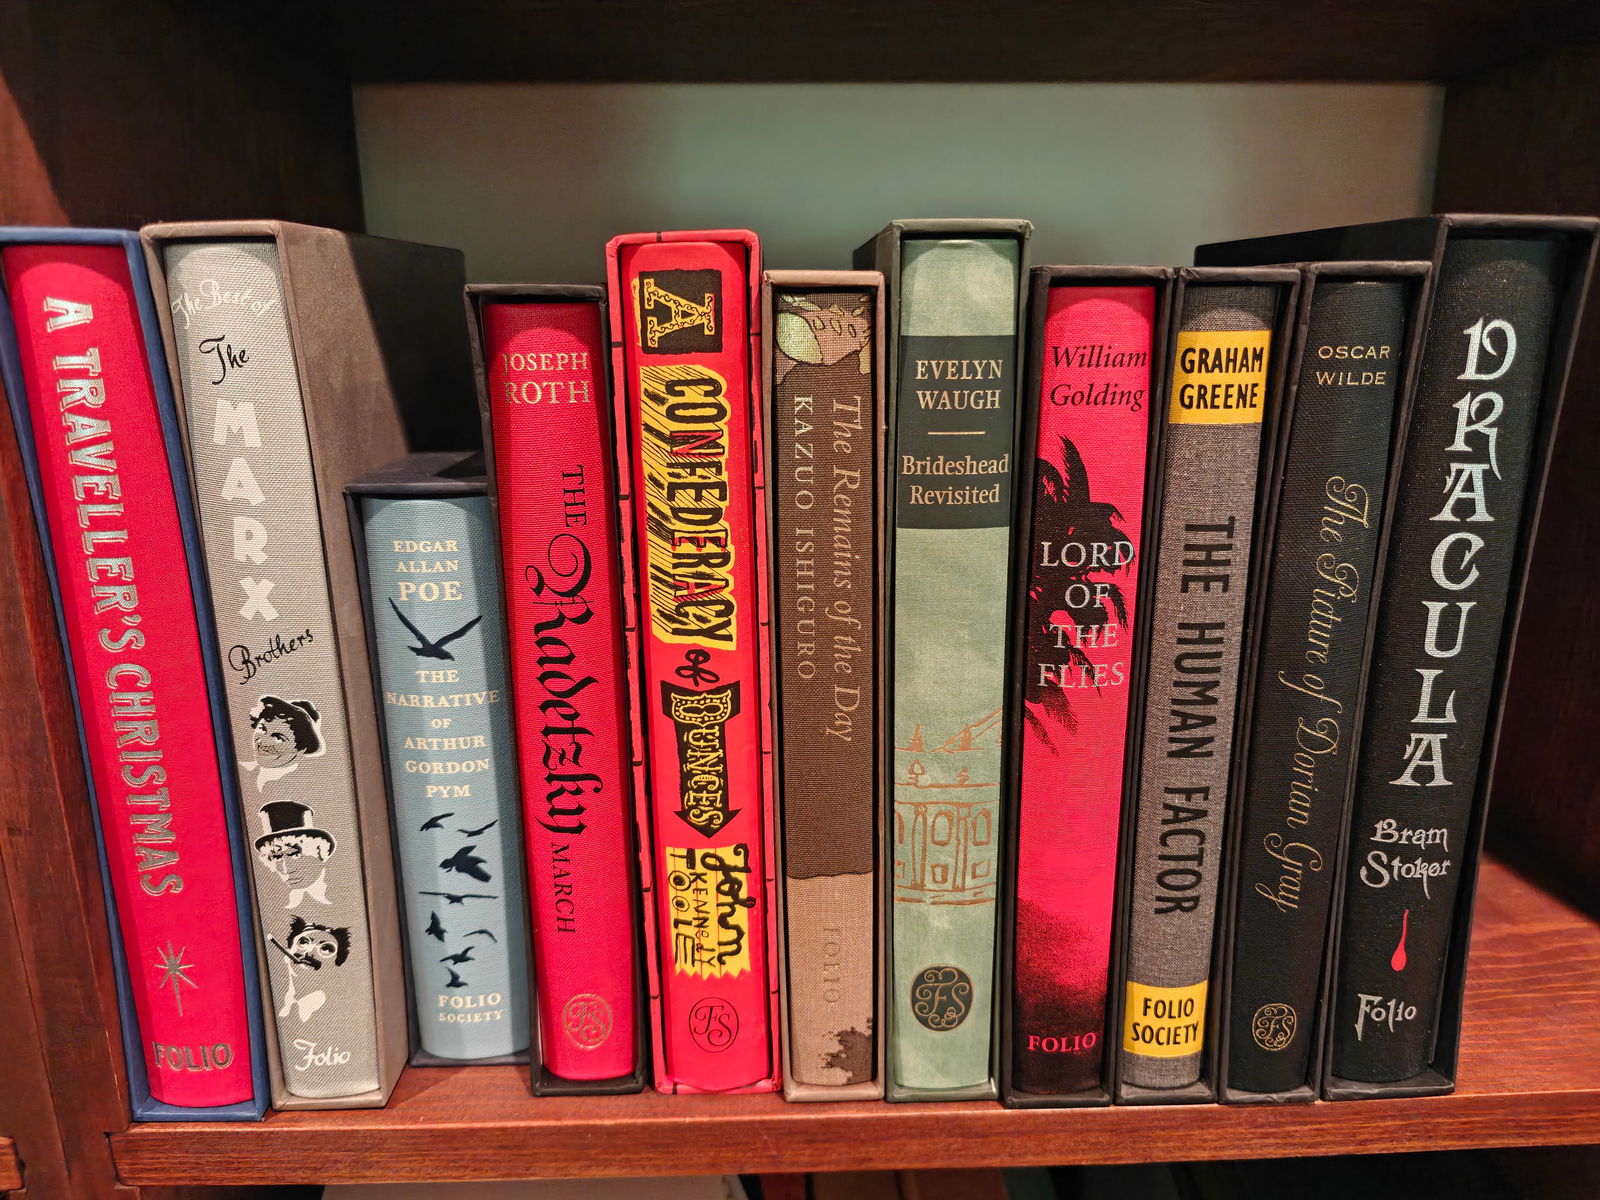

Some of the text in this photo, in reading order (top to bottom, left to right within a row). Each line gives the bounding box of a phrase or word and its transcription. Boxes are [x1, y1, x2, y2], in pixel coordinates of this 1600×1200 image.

[199, 335, 250, 385] The
[503, 351, 589, 376] JOSEPH
[1052, 344, 1147, 369] William
[1180, 347, 1265, 374] GRAHAM
[1317, 345, 1390, 360] OSCAR
[914, 359, 1004, 381] EVELYN
[1316, 371, 1387, 386] WILDE
[505, 380, 591, 405] ROTH
[915, 389, 1001, 411] WAUGH
[1050, 382, 1145, 413] Golding
[1179, 382, 1260, 410] GREENE
[901, 453, 1010, 477] Brideshead
[909, 484, 1001, 506] Revisited
[212, 399, 280, 622] MARX
[392, 540, 458, 553] EDGAR
[793, 395, 817, 680] KAZUO ISHIGURO
[643, 277, 735, 829] A CONFEDERACY of DUNCES
[1040, 540, 1135, 568] LORD
[1389, 316, 1518, 787] DRACULA
[396, 560, 459, 573] ALLAN
[825, 395, 862, 743] The Remains of the Day
[43, 296, 94, 333] A
[105, 663, 184, 897] CHRISTMAS
[399, 581, 463, 602] POE
[1064, 583, 1111, 609] OF
[1048, 623, 1119, 650] THE
[228, 628, 314, 686] Brothers
[416, 669, 460, 683] THE
[1037, 662, 1125, 689] FLIES
[384, 690, 499, 708] NARRATIVE
[525, 464, 603, 934] THE Radetzky MARCH
[1255, 475, 1370, 913] The Picture of Dorian Gray
[431, 718, 451, 729] OF
[1154, 516, 1236, 915] THE HUMAN FACTOR
[404, 735, 486, 749] ARTHUR
[404, 759, 490, 774] GORDON
[426, 785, 472, 798] PYM
[1370, 818, 1449, 852] Bram
[1360, 851, 1450, 899] Stoker
[667, 848, 698, 967] TOOLE
[700, 843, 757, 966] John
[822, 926, 841, 1004] FOLIO
[437, 992, 502, 1009] FOLIO
[1143, 997, 1195, 1020] FOLIO
[438, 1009, 503, 1023] SOCIETY
[1355, 993, 1417, 1042] Folio
[1027, 1032, 1098, 1053] FOLIO
[1131, 1020, 1199, 1047] SOCIETY
[152, 1042, 234, 1071] FOLIO
[293, 1039, 351, 1071] Folio
